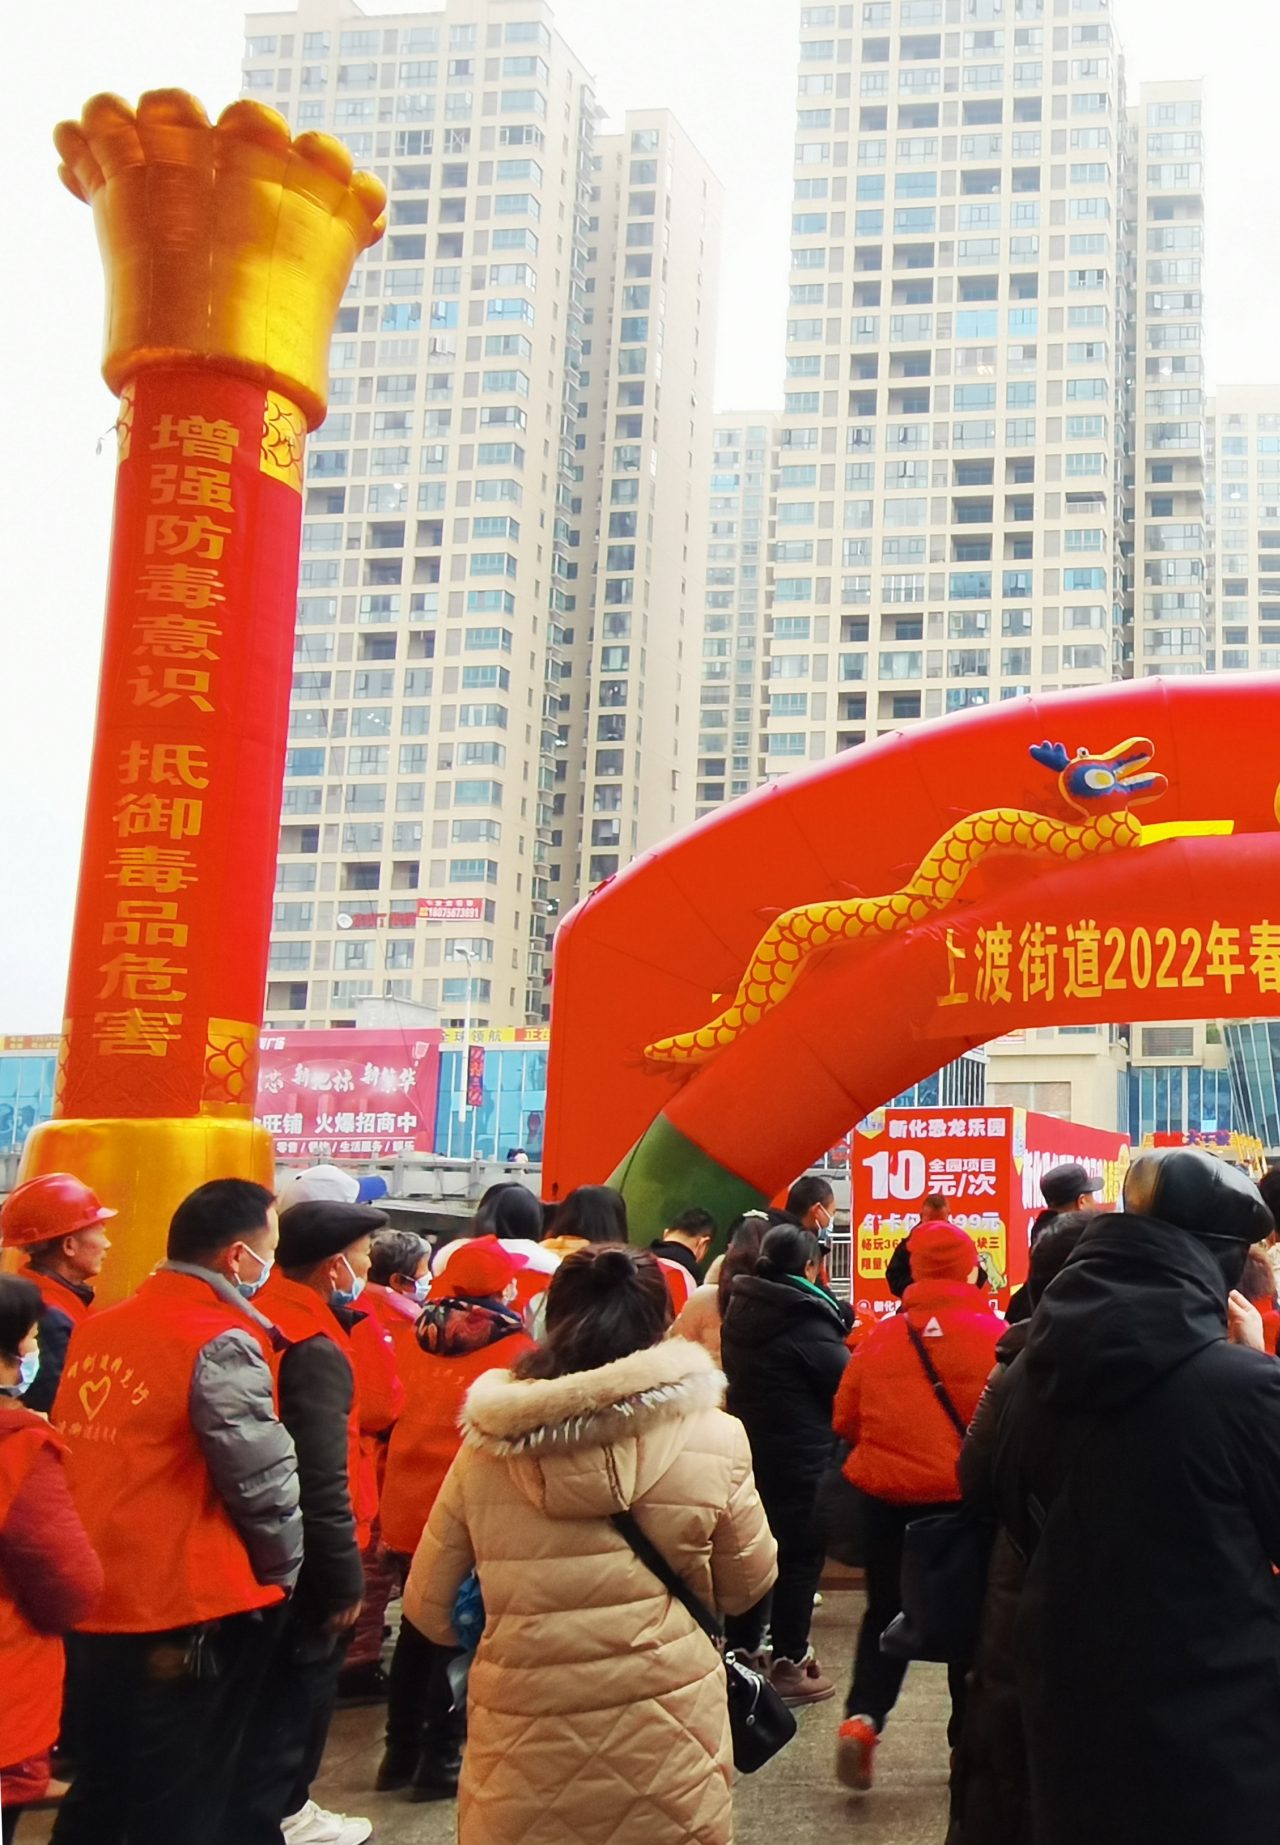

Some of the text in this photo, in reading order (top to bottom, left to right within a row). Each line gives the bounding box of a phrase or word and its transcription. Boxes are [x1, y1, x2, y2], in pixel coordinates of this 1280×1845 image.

[92, 414, 240, 1057] 增强防毒意识 抵御毒品危害
[253, 1111, 417, 1135] 旺铺 火爆招商中
[888, 1117, 1006, 1139] 新化恐龙乐园
[861, 1149, 926, 1200] 10
[928, 1158, 996, 1173] 全园项目
[928, 1173, 997, 1198] 元/次
